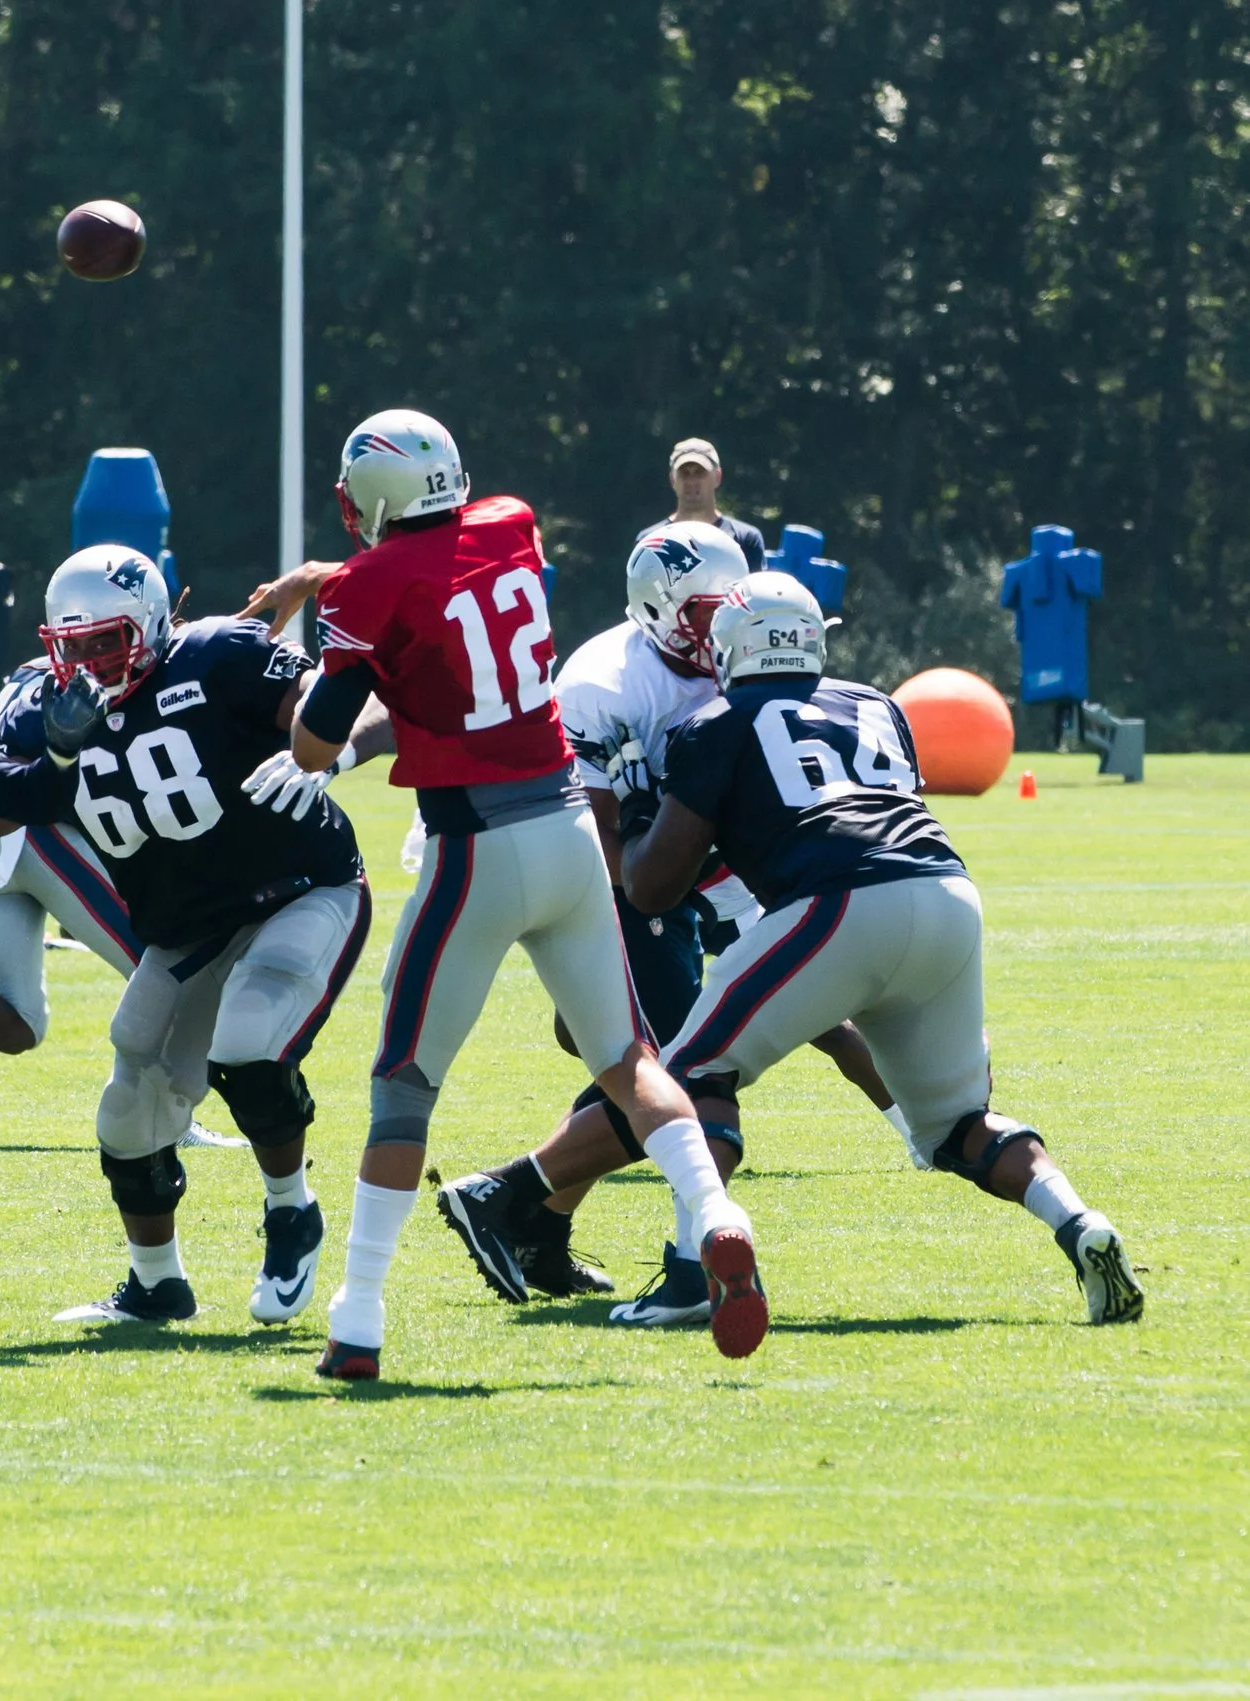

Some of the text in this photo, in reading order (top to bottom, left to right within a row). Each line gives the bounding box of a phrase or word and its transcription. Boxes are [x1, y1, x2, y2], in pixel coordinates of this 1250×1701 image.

[426, 471, 447, 495] 12
[421, 493, 456, 509] PATRIOTS
[443, 567, 557, 731] 12
[760, 657, 806, 670] PATRIOTS
[160, 688, 200, 709] Gillette
[752, 699, 916, 808] 64
[74, 726, 224, 859] 68
